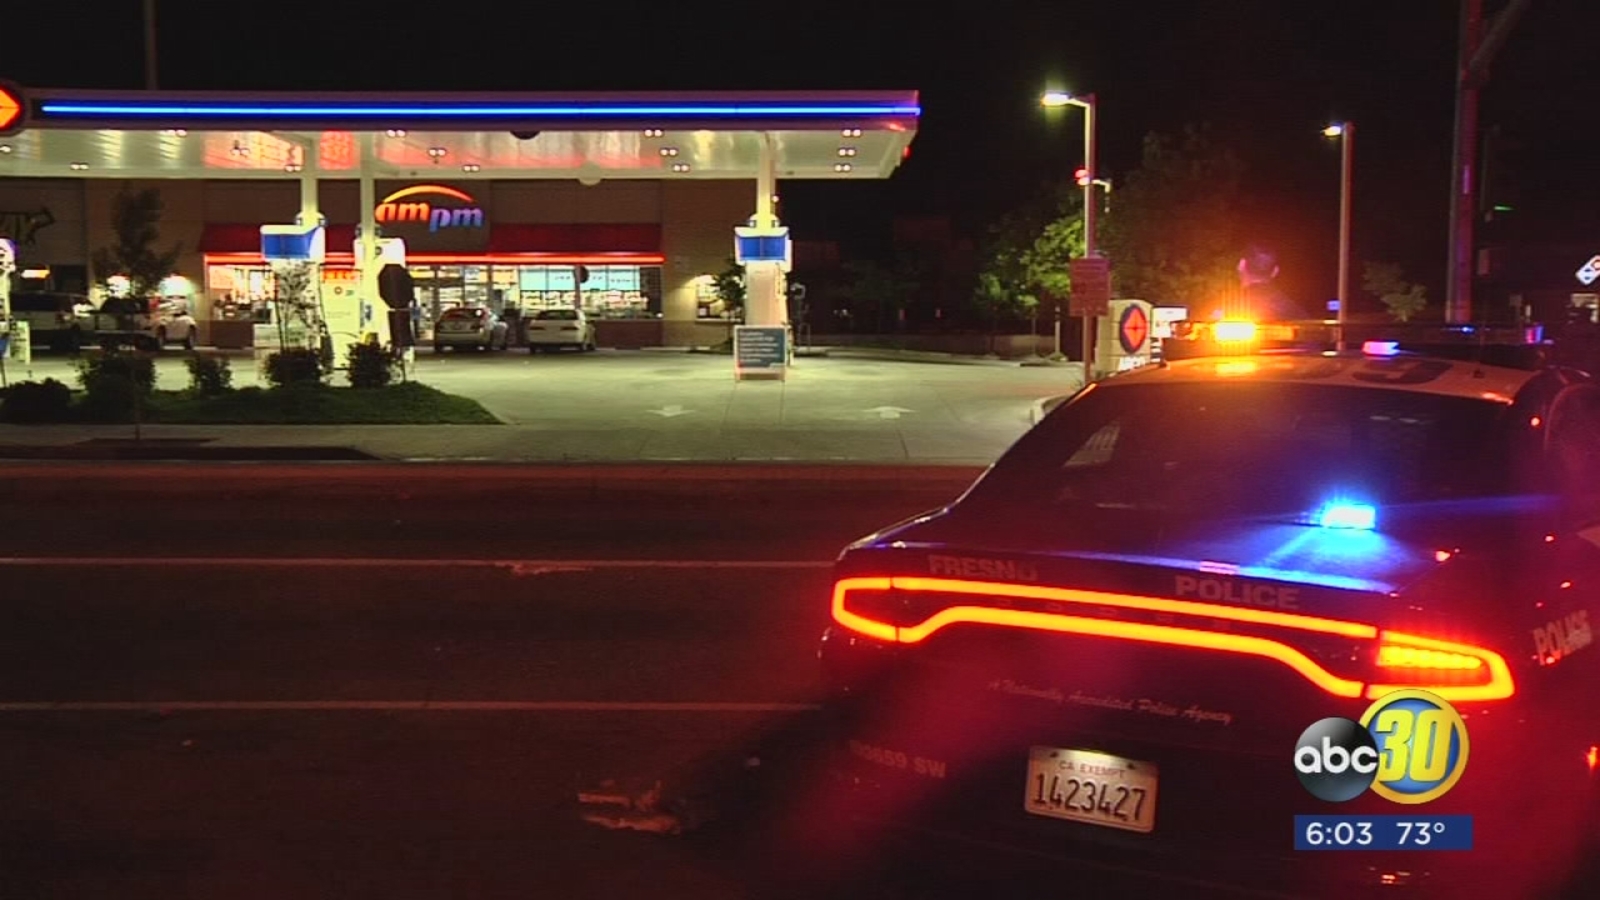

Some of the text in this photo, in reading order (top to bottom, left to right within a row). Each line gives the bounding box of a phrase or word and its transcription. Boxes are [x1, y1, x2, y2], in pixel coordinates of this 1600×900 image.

[375, 202, 484, 233] ampm
[927, 554, 1299, 610] FRESNO POLICE
[913, 756, 946, 779] SW
[1059, 761, 1126, 778] CA EXEMPT
[1034, 773, 1147, 821] 1423427
